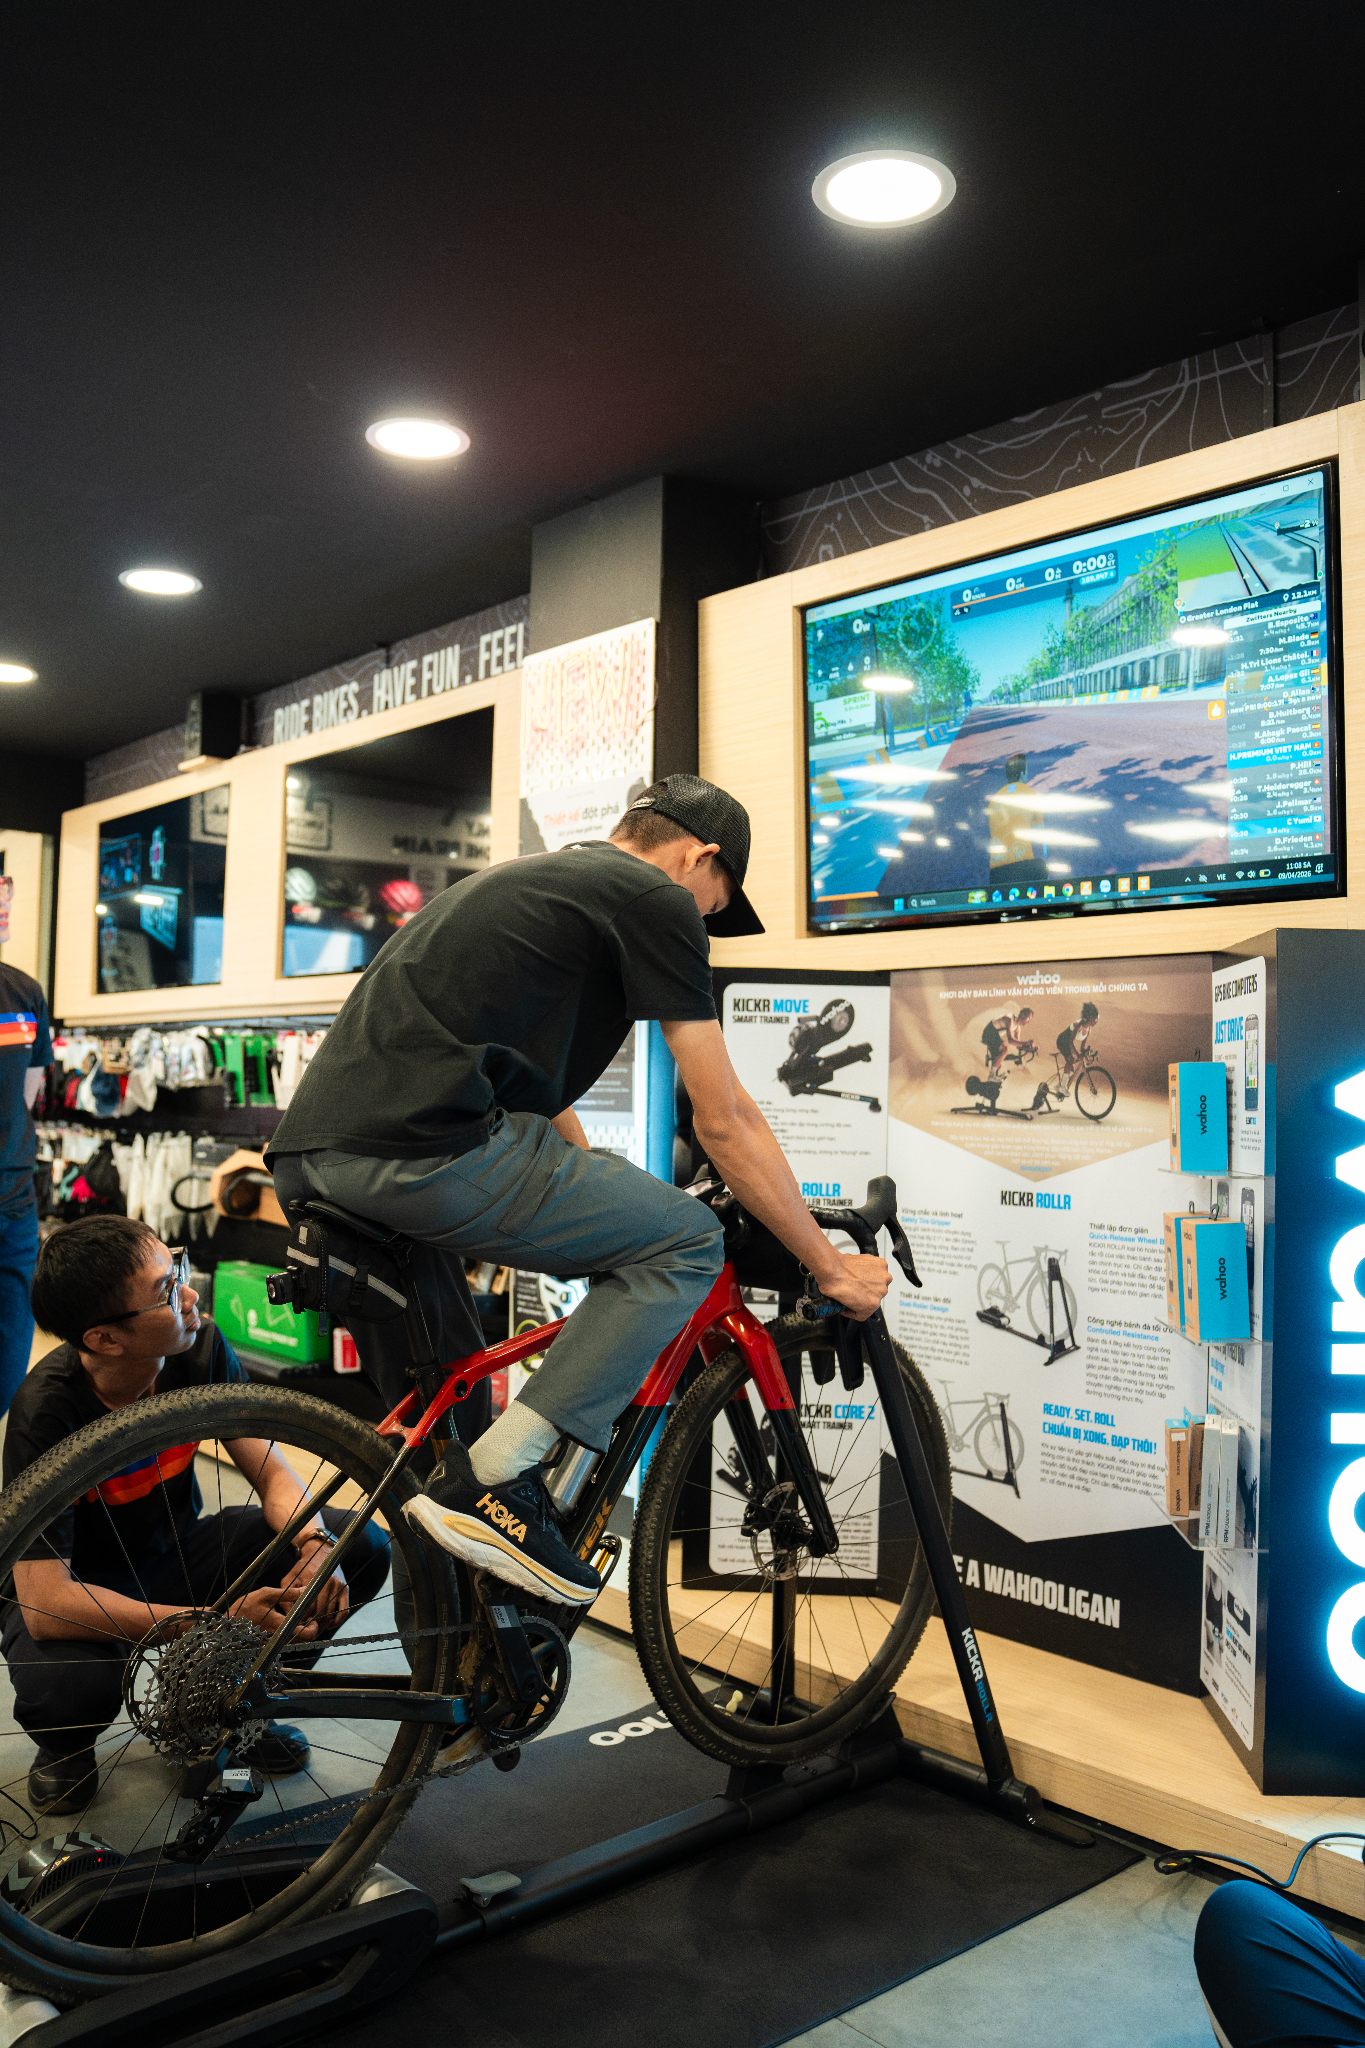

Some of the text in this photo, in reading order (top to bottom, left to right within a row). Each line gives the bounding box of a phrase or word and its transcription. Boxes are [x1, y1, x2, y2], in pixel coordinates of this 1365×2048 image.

[1072, 554, 1107, 574] 0:00
[1186, 601, 1258, 622] Greater London Flat
[1246, 608, 1297, 623] Zwifters Nearby
[273, 698, 310, 745] RIDE
[373, 660, 418, 715] HAVE
[842, 694, 870, 706] SPRINT
[1275, 744, 1293, 755] VIET
[1294, 742, 1312, 752] NAM
[601, 804, 620, 818] phá
[1278, 870, 1312, 880] 09/04/2026
[1016, 970, 1061, 985] wahoo
[1064, 984, 1091, 994] TRONG
[1108, 982, 1136, 993] CHÚNG
[1138, 982, 1148, 992] TA
[1214, 983, 1222, 1002] GPS
[1232, 974, 1258, 998] COMPUTERS
[733, 998, 809, 1013] KICKR MOVE
[732, 1016, 790, 1025] SMART TRAINER
[1214, 1016, 1244, 1044] JUST DRIVE
[1196, 1094, 1208, 1136] wahoo
[802, 1182, 841, 1197] ROLLR
[822, 1198, 853, 1207] TRAINER
[1000, 1190, 1072, 1210] KICKR ROLLR
[1138, 1236, 1158, 1244] Wheel
[1216, 1257, 1228, 1301] wahoo
[1088, 1316, 1104, 1326] Công
[1087, 1326, 1160, 1342] Controlled Resistance
[834, 1404, 866, 1420] CORE
[868, 1404, 876, 1420] 2
[1043, 1402, 1073, 1420] READY.
[1094, 1411, 1116, 1428] ROLL
[800, 1421, 853, 1431] MART TRAINER
[1072, 1427, 1082, 1444] BỊ
[1083, 1428, 1110, 1446] XONG.
[1111, 1434, 1130, 1452] ĐẠP
[476, 1492, 528, 1544] HOKA
[966, 1559, 980, 1589] A
[984, 1562, 1121, 1629] WAHOOLIGAN
[962, 1626, 994, 1722] KICKR ROLLR
